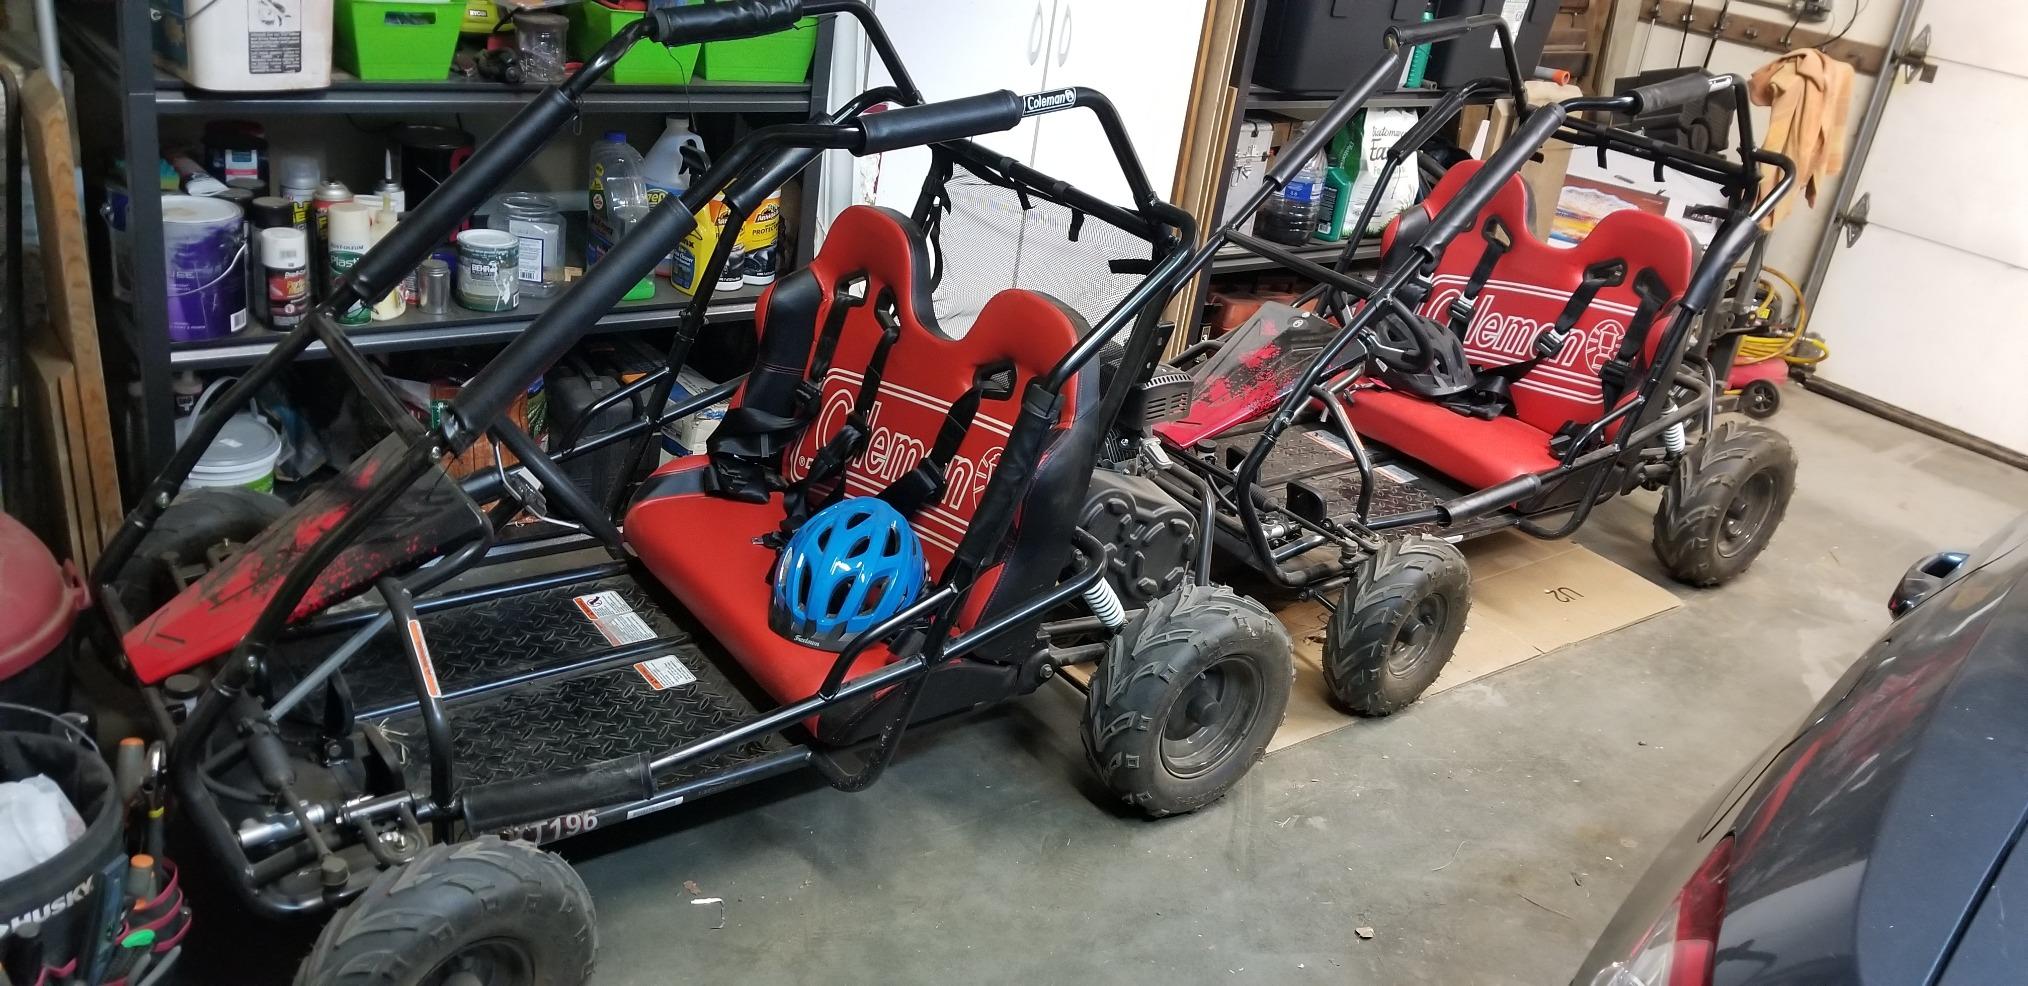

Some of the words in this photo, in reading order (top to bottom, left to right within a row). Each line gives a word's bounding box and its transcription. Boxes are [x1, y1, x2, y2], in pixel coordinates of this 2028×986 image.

[1027, 94, 1066, 110] Coleman
[1426, 289, 1586, 366] Clemn
[816, 388, 974, 511] Clemn
[514, 809, 598, 848] T196
[11, 873, 94, 927] HUSKY
